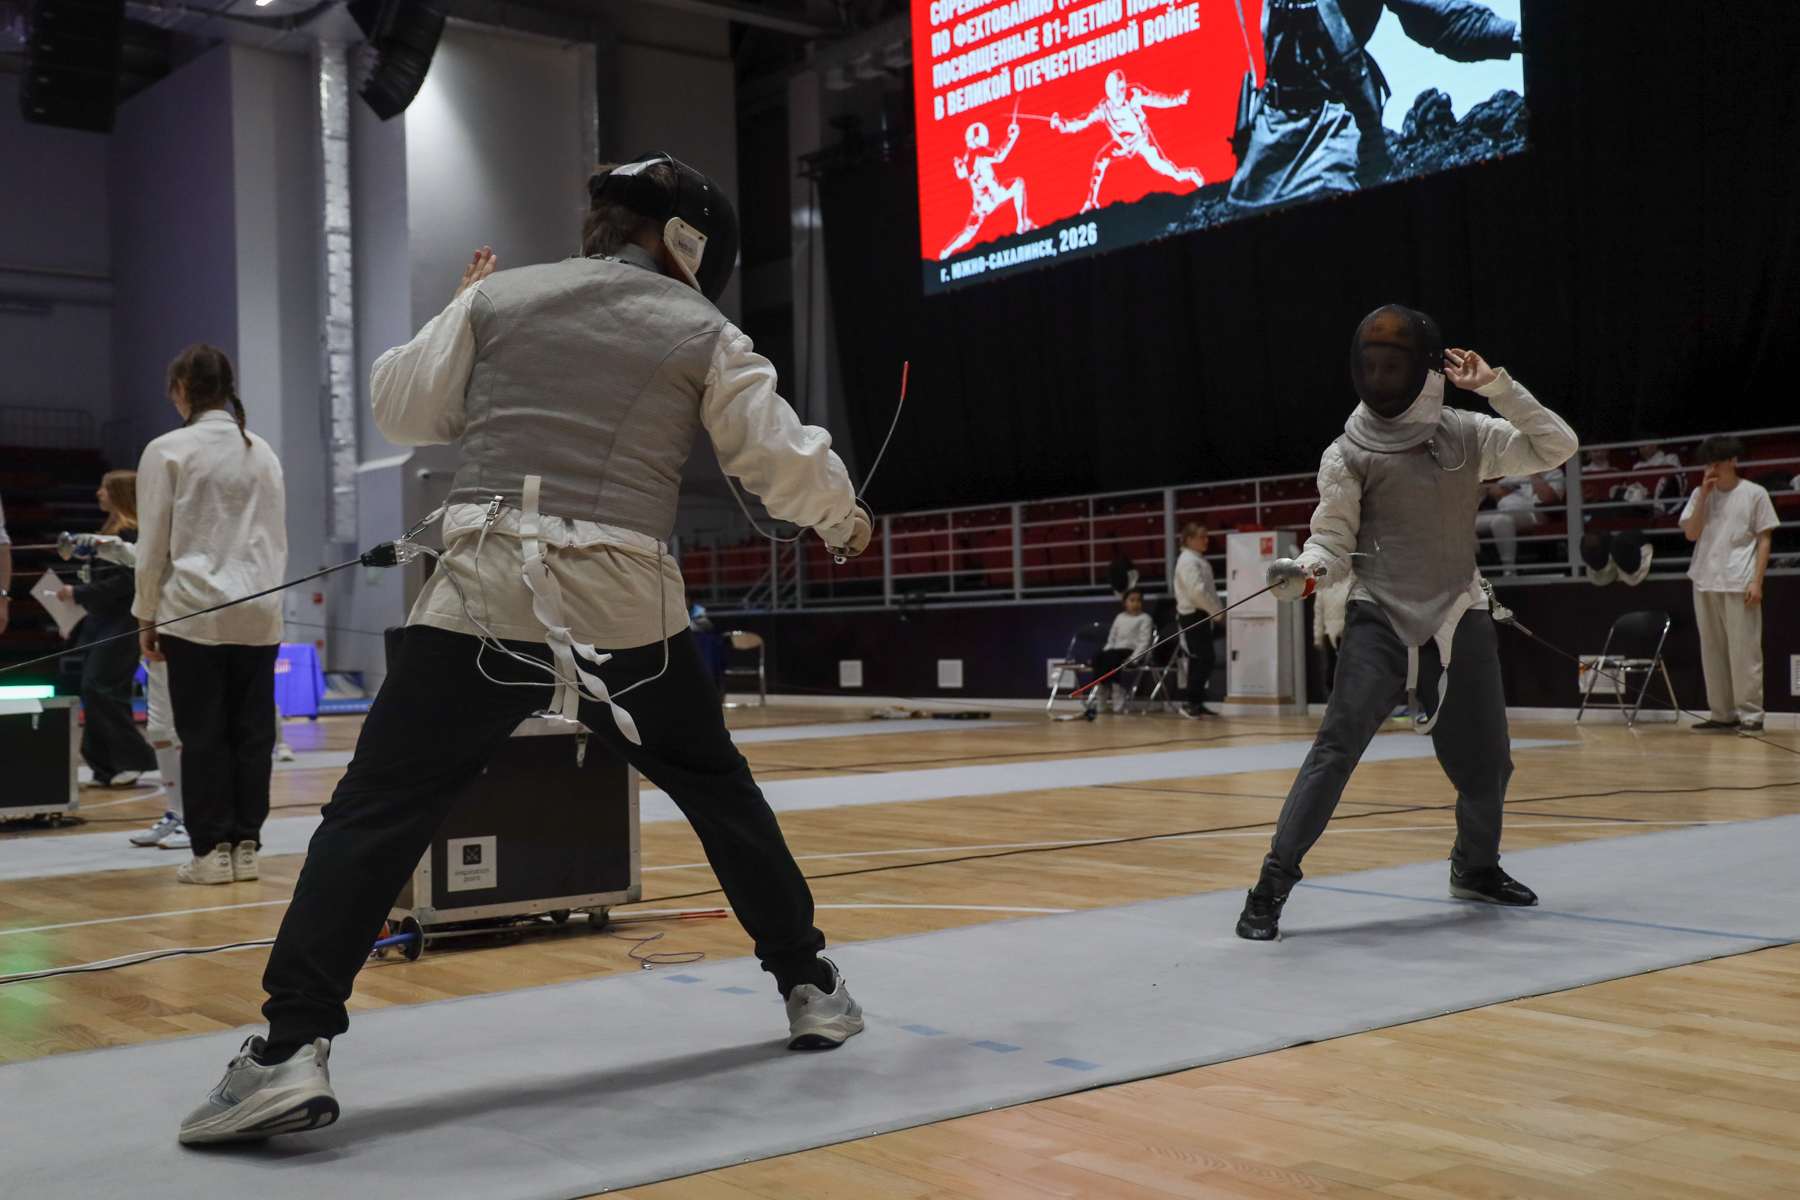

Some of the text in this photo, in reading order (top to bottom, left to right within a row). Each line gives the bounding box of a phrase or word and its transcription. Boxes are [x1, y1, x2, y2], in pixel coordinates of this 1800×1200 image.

[931, 0, 1054, 58] ПО ФЕХТОВАНИЮ
[932, 0, 1123, 89] ПОСВЯЩЕННЫЕ 81-ЛЕТИЮ
[934, 2, 1200, 121] В ВЕЛИКОЙ ОТЕЧЕСТВЕННОЙ ВОЙНЕ
[1059, 222, 1098, 252] 2026
[454, 868, 490, 877] inspiration
[463, 875, 481, 883] point
